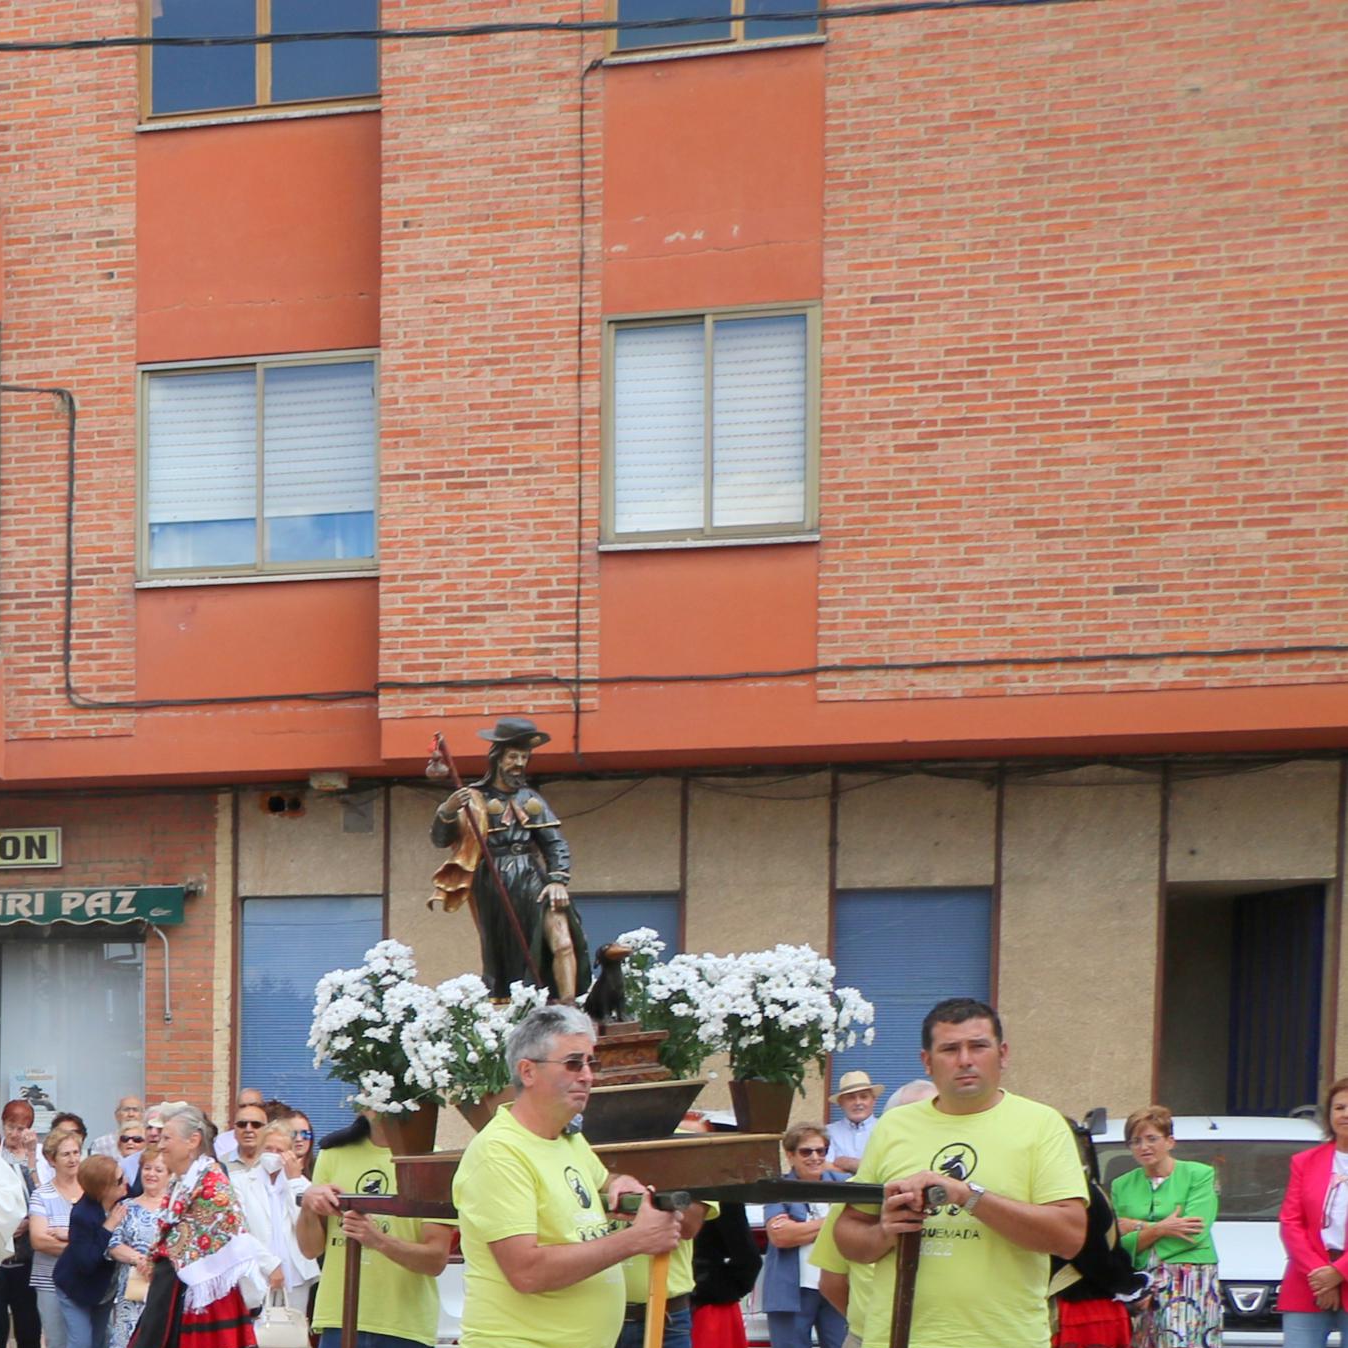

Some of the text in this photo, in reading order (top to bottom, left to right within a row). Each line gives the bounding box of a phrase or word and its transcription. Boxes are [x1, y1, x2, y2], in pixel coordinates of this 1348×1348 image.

[60, 890, 138, 918] PAZ
[921, 1227, 981, 1240] QUEMADA
[921, 1241, 953, 1256] 022
